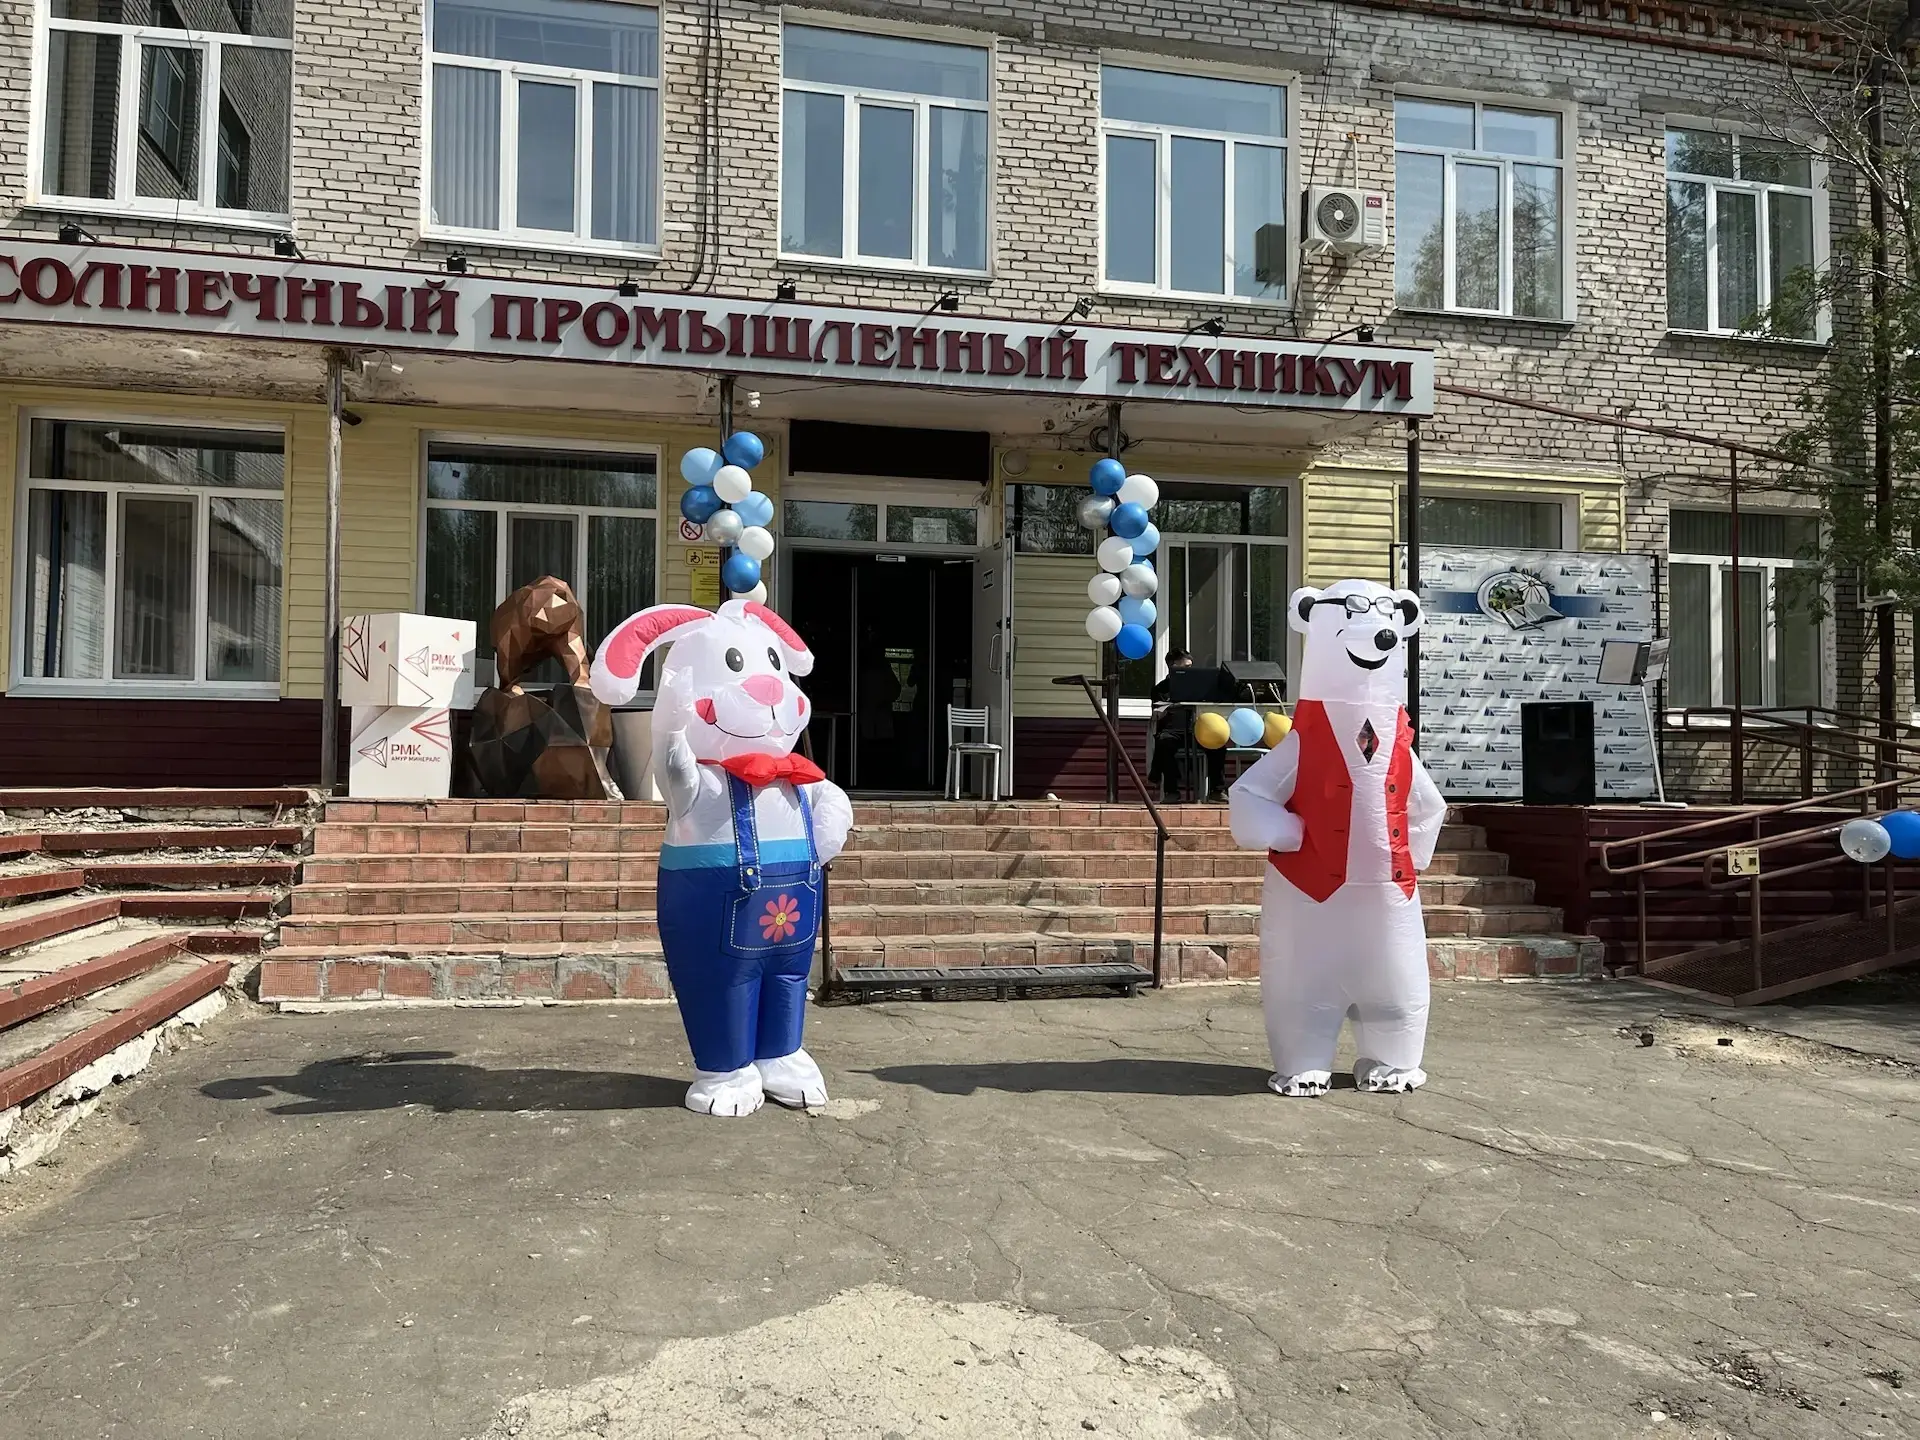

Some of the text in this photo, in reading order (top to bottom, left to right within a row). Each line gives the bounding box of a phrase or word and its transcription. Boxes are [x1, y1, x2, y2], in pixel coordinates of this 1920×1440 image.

[490, 293, 1088, 380] ПРОМЫШЛЕННЫЙ
[1109, 341, 1414, 400] ТЕХНИКУМ
[431, 653, 456, 666] РМК
[391, 744, 421, 755] РМК
